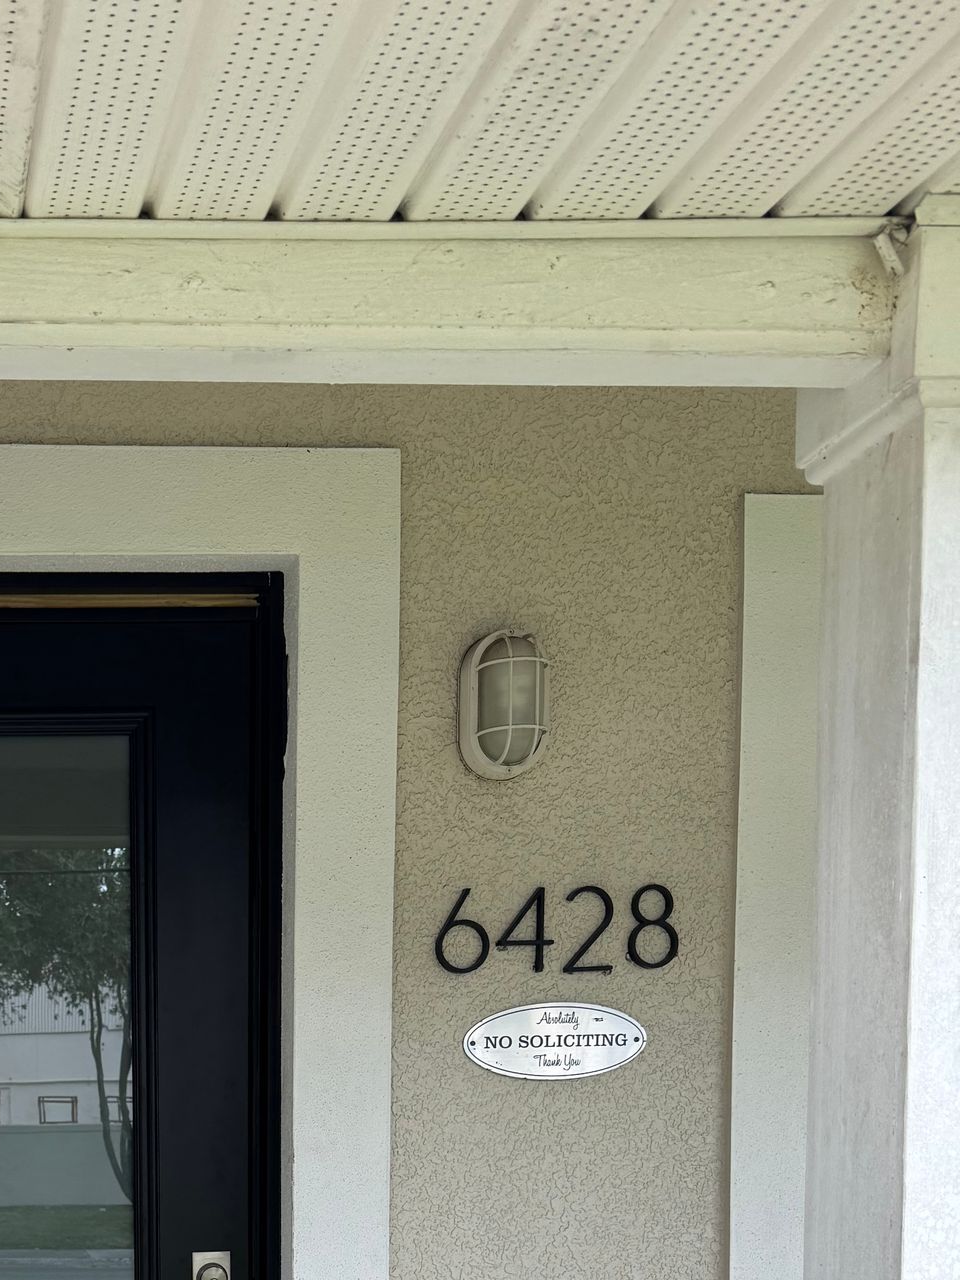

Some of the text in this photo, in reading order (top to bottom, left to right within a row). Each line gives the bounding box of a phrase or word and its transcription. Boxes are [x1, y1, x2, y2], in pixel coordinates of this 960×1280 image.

[435, 884, 679, 974] 6428
[536, 1011, 579, 1029] Absolutely
[484, 1033, 628, 1049] NO SOLICITING
[533, 1054, 581, 1071] Thank You
